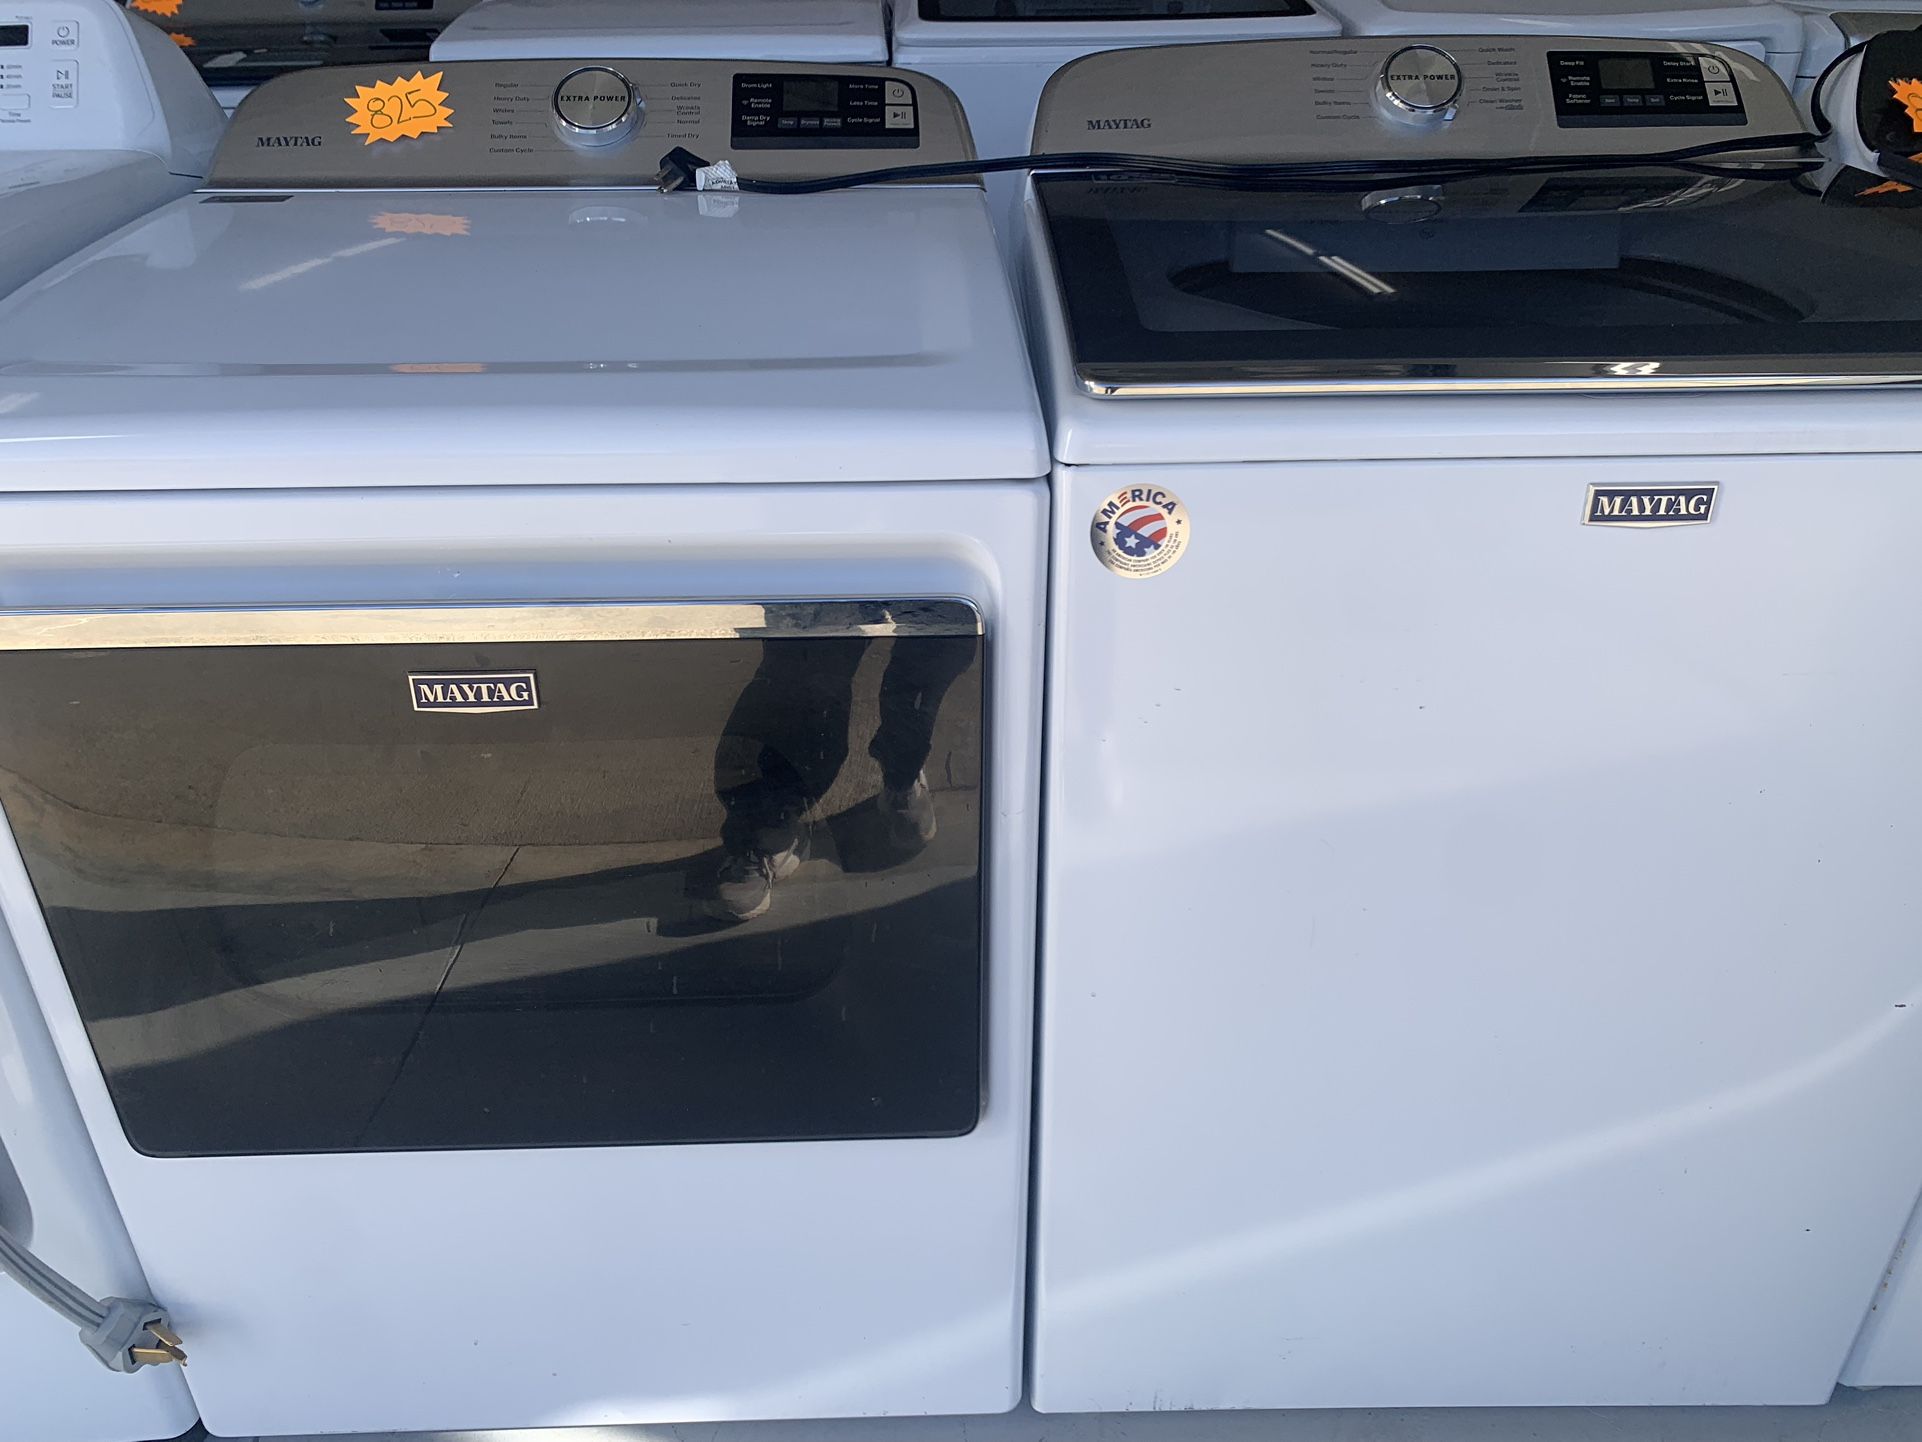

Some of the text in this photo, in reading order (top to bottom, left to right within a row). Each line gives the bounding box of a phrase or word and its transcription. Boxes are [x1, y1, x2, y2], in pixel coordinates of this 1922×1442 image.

[366, 89, 437, 129] 825
[1087, 118, 1152, 130] MAYTAG
[256, 135, 323, 148] MAYTAG
[1095, 488, 1177, 534] AMERICA
[1594, 494, 1708, 516] MAYTAG
[417, 682, 530, 703] MAYTAG
